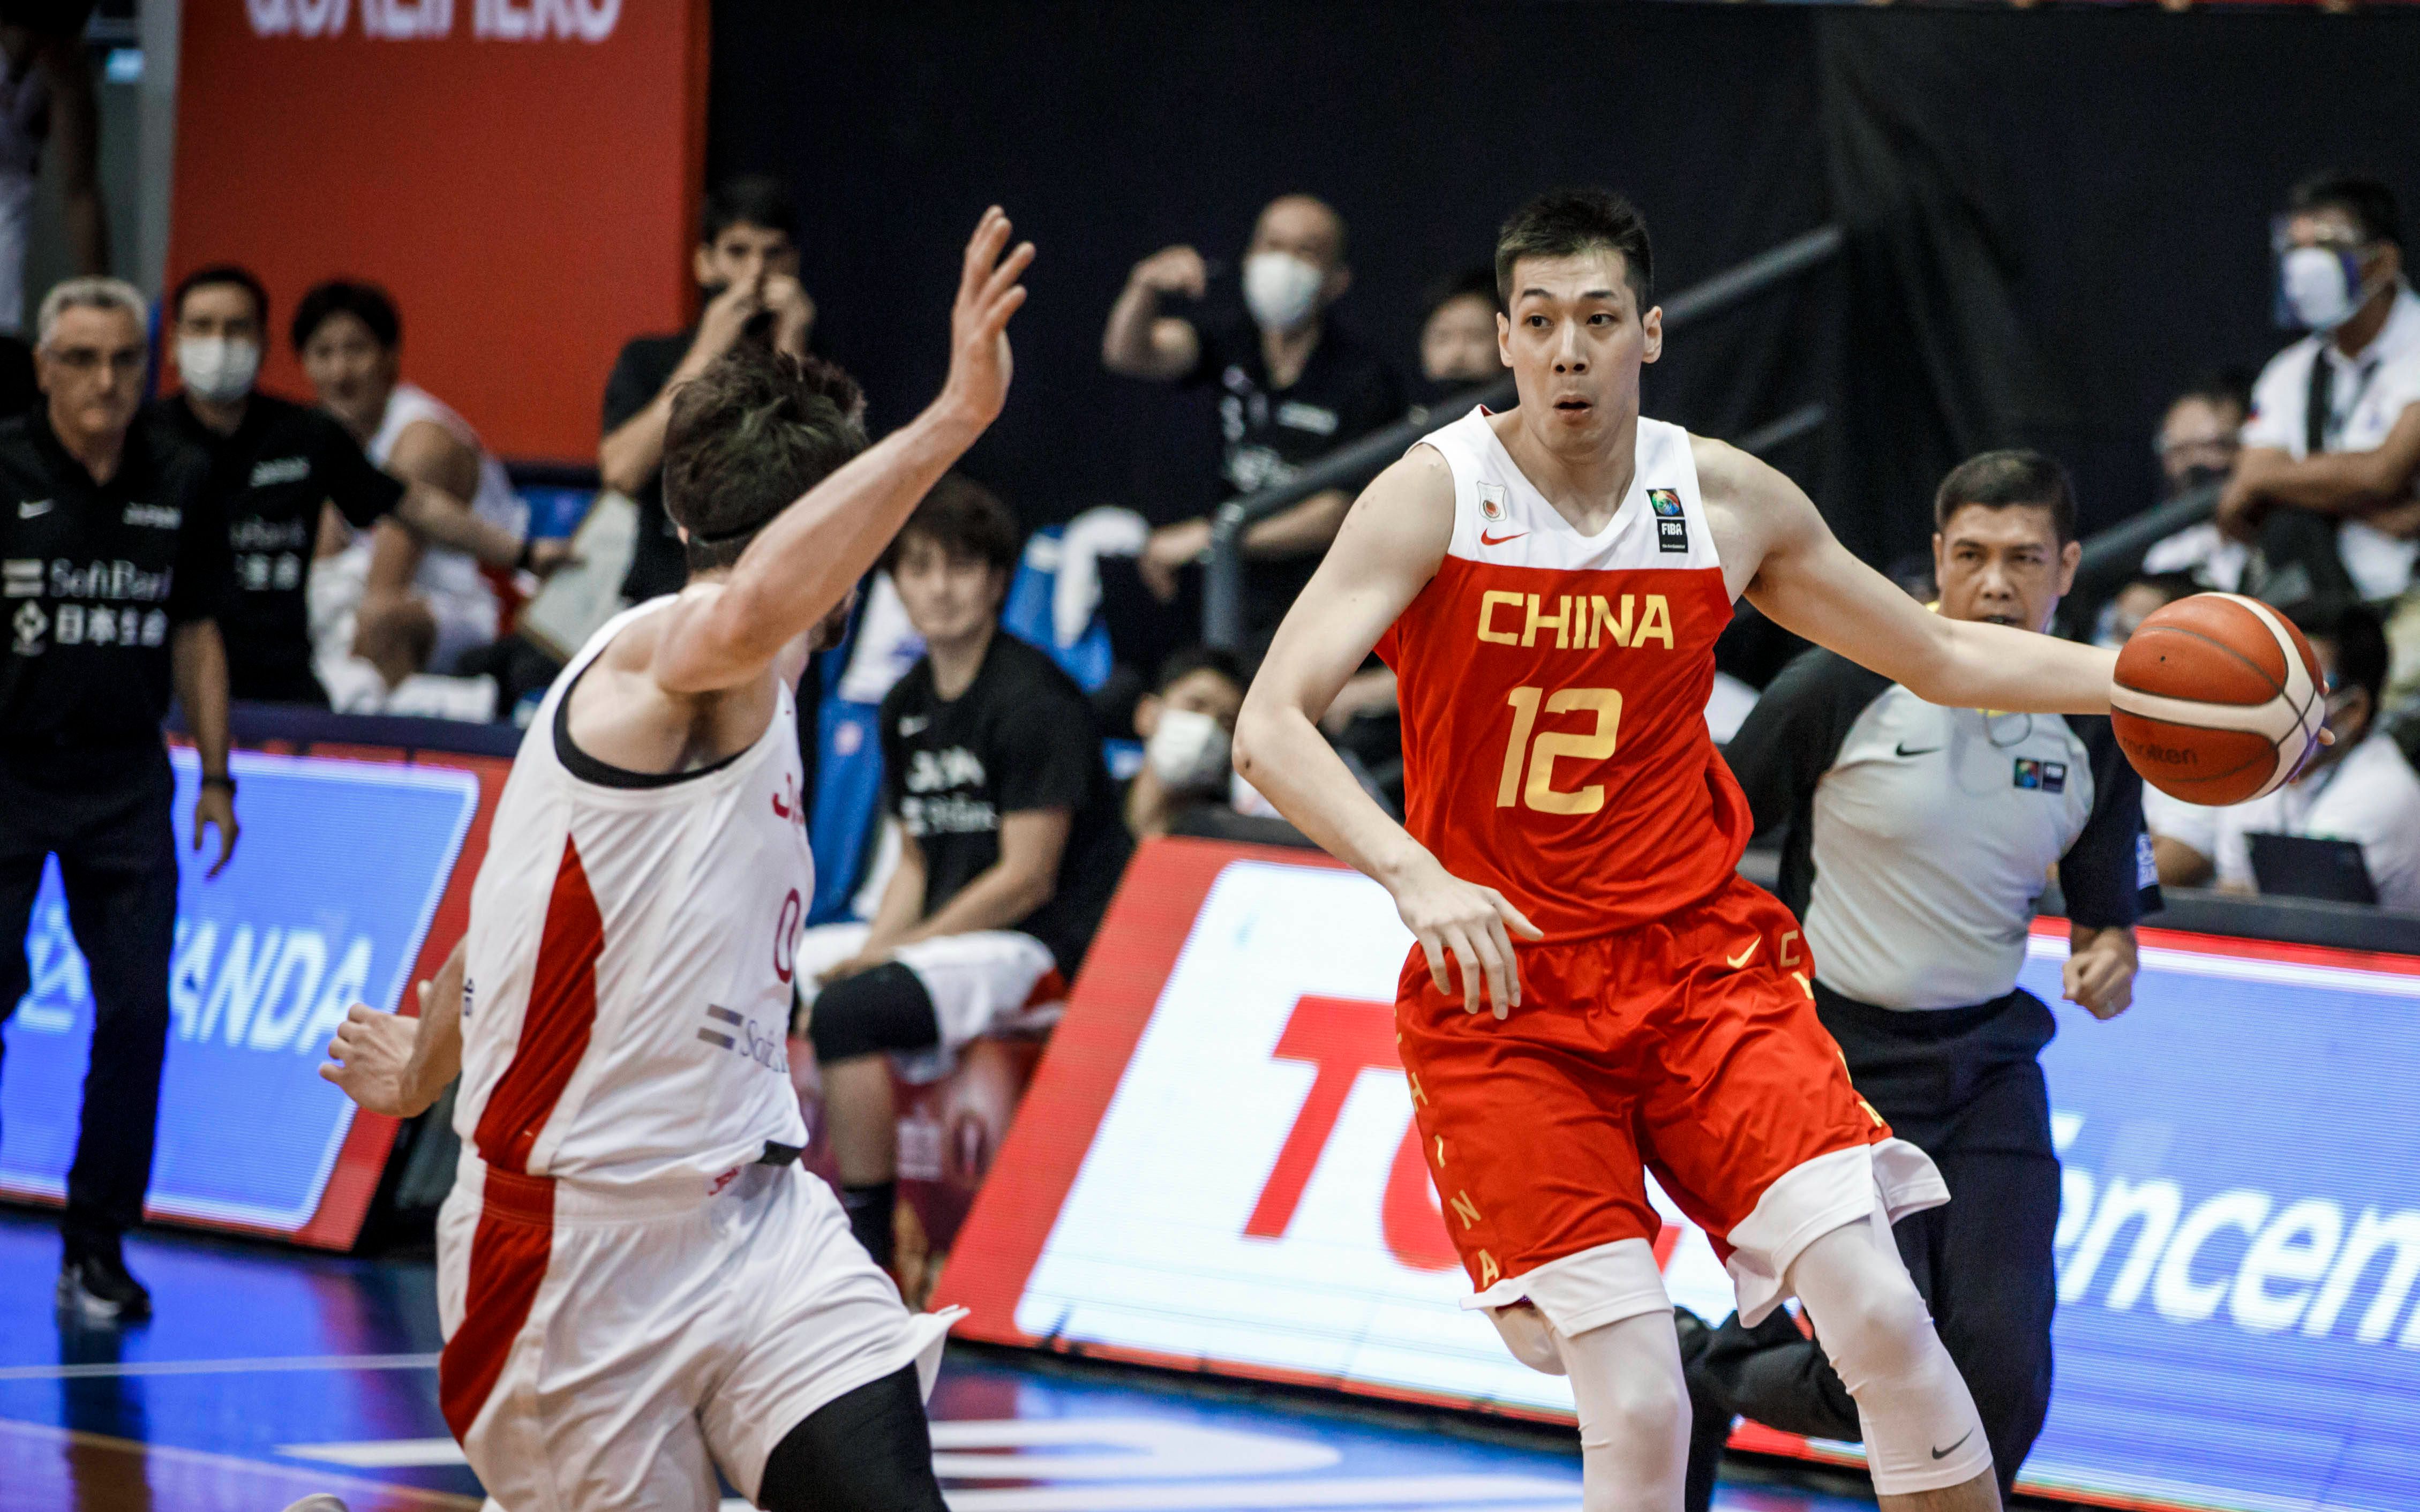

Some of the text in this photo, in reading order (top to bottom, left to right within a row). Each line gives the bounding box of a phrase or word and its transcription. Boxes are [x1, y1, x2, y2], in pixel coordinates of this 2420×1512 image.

[1662, 523, 1682, 536] FIBA
[1477, 590, 1674, 650] CHINA
[1496, 686, 1624, 815] 12
[773, 887, 800, 983] 0
[172, 917, 373, 1054] ANDA
